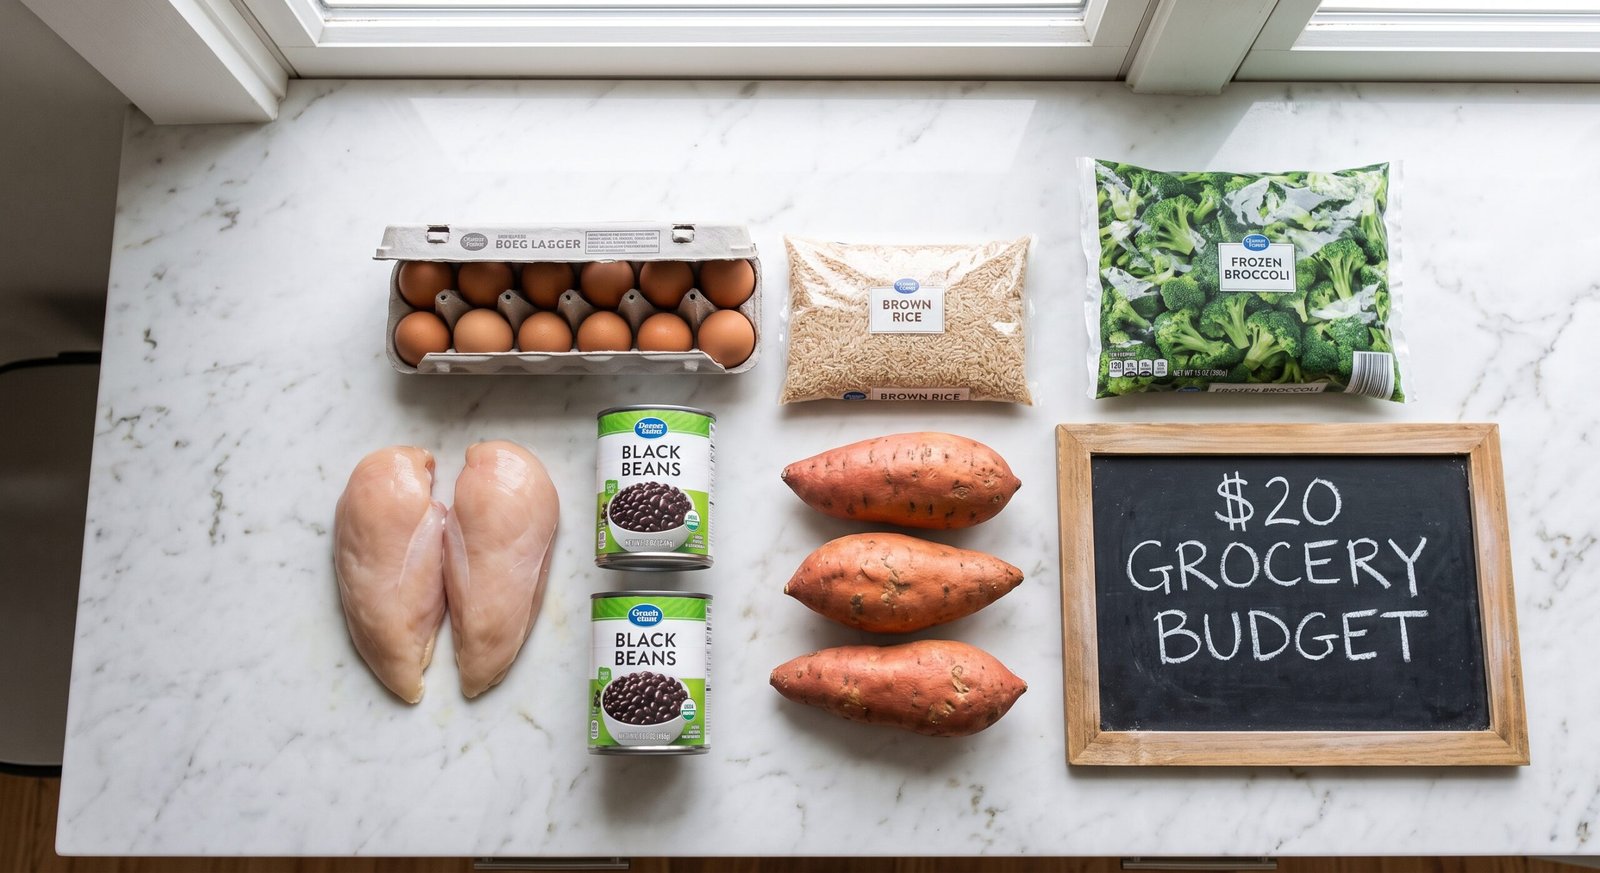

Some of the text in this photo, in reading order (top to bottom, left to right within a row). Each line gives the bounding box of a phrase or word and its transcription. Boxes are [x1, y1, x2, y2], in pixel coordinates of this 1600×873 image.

[495, 239, 528, 249] BOEG
[1231, 257, 1282, 267] FROZEN
[1224, 269, 1289, 280] BROCCOLI
[882, 299, 932, 310] BROWN
[892, 311, 922, 322] RICE
[1110, 361, 1122, 369] 120
[622, 445, 681, 460] BLACK
[622, 461, 681, 477] BEANS
[1214, 470, 1342, 532] $20
[1126, 536, 1427, 597] GROCERY
[616, 632, 677, 648] BLACK
[1154, 608, 1429, 664] BUDGET
[615, 651, 677, 666] BEANS
